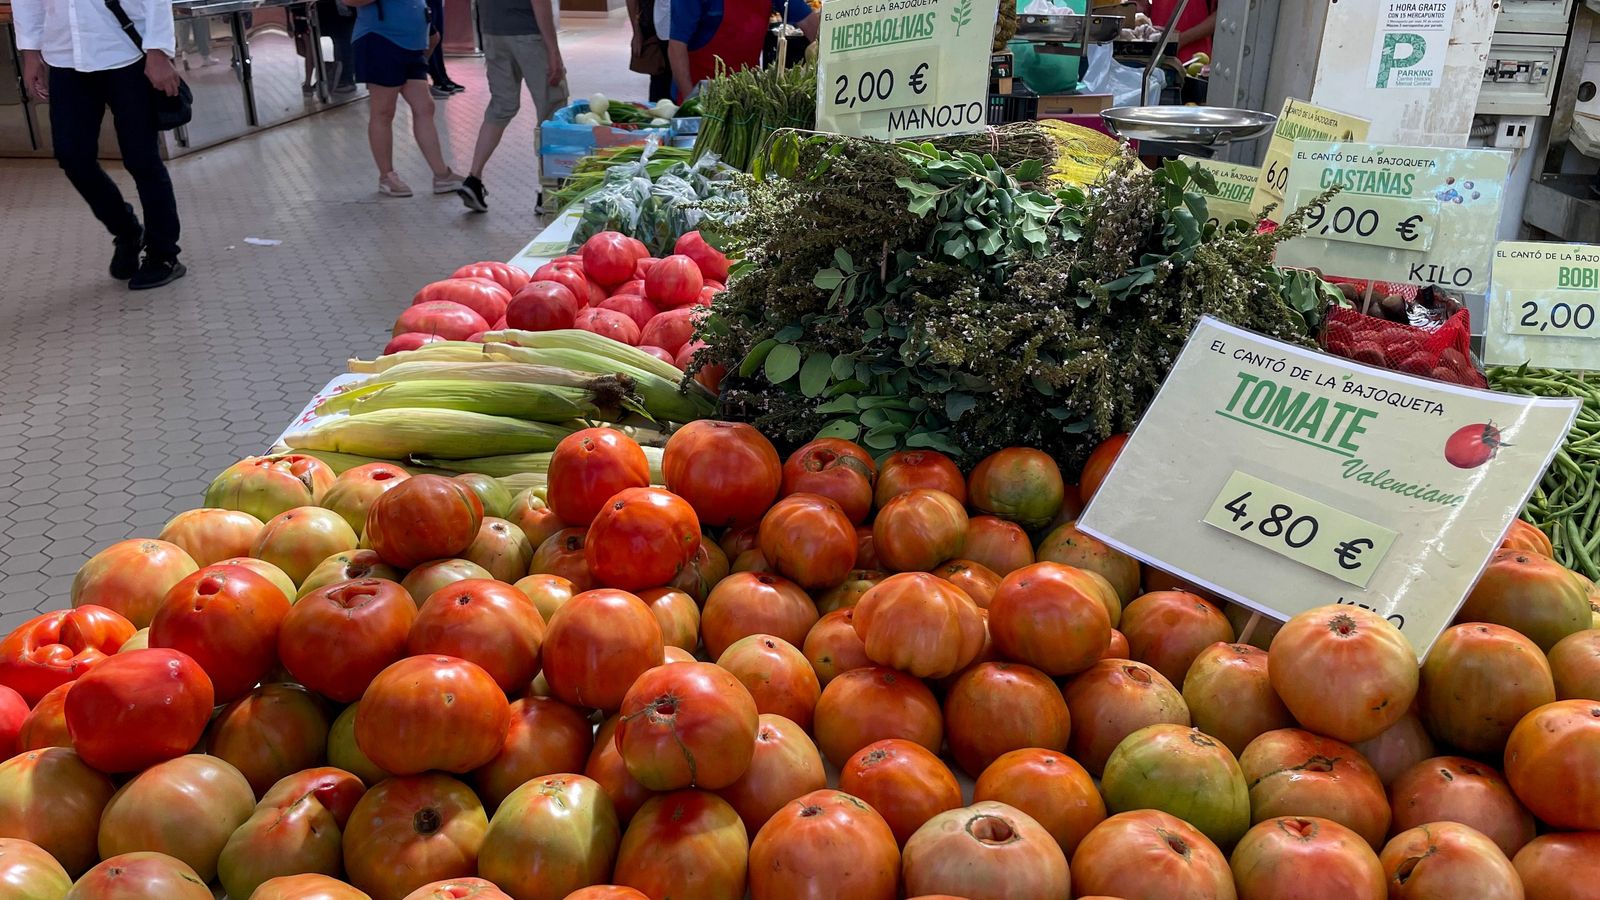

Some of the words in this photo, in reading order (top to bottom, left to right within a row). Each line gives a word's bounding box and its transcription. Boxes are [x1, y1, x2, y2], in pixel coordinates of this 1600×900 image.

[836, 6, 860, 20] CANTÓ
[863, 6, 873, 15] DE
[875, 4, 886, 13] LA
[889, 0, 938, 11] BAJOQUETA
[1395, 3, 1416, 11] HORA
[1418, 3, 1447, 11] GRATIS
[830, 11, 936, 51] HIERBAOLIVAS
[1375, 33, 1427, 88] P
[1397, 69, 1433, 77] PARKING
[834, 68, 894, 109] 2,00
[908, 62, 929, 95] €
[887, 101, 983, 133] MANOJO
[1275, 118, 1299, 139] OLIVAS
[1296, 124, 1337, 142] MANZANI
[1297, 152, 1308, 161] EL
[1310, 151, 1343, 163] CANTÓ
[1346, 154, 1359, 163] DE
[1361, 155, 1374, 164] LA
[1377, 156, 1436, 168] BAJOQUETA
[1186, 180, 1255, 202] ALCHOFA
[1266, 160, 1288, 193] 6,0
[1319, 167, 1416, 196] CASTAÑAS
[1303, 202, 1379, 237] 9,00
[1395, 214, 1423, 242] €
[1510, 249, 1542, 259] CANTÓ
[1545, 252, 1556, 260] DE
[1560, 253, 1572, 261] LA
[1575, 255, 1600, 263] BAJO
[1408, 261, 1473, 287] KILO
[1558, 266, 1599, 289] BOBI
[1520, 301, 1595, 332] 2,00
[1210, 339, 1229, 354] EL
[1232, 347, 1287, 373] CANTÓ
[1289, 365, 1313, 380] DE
[1315, 372, 1337, 388] LA
[1341, 380, 1445, 417] BAJOQUETA
[1224, 371, 1379, 453] TOMATE
[1223, 490, 1320, 550] 4,80
[1333, 537, 1375, 571] €
